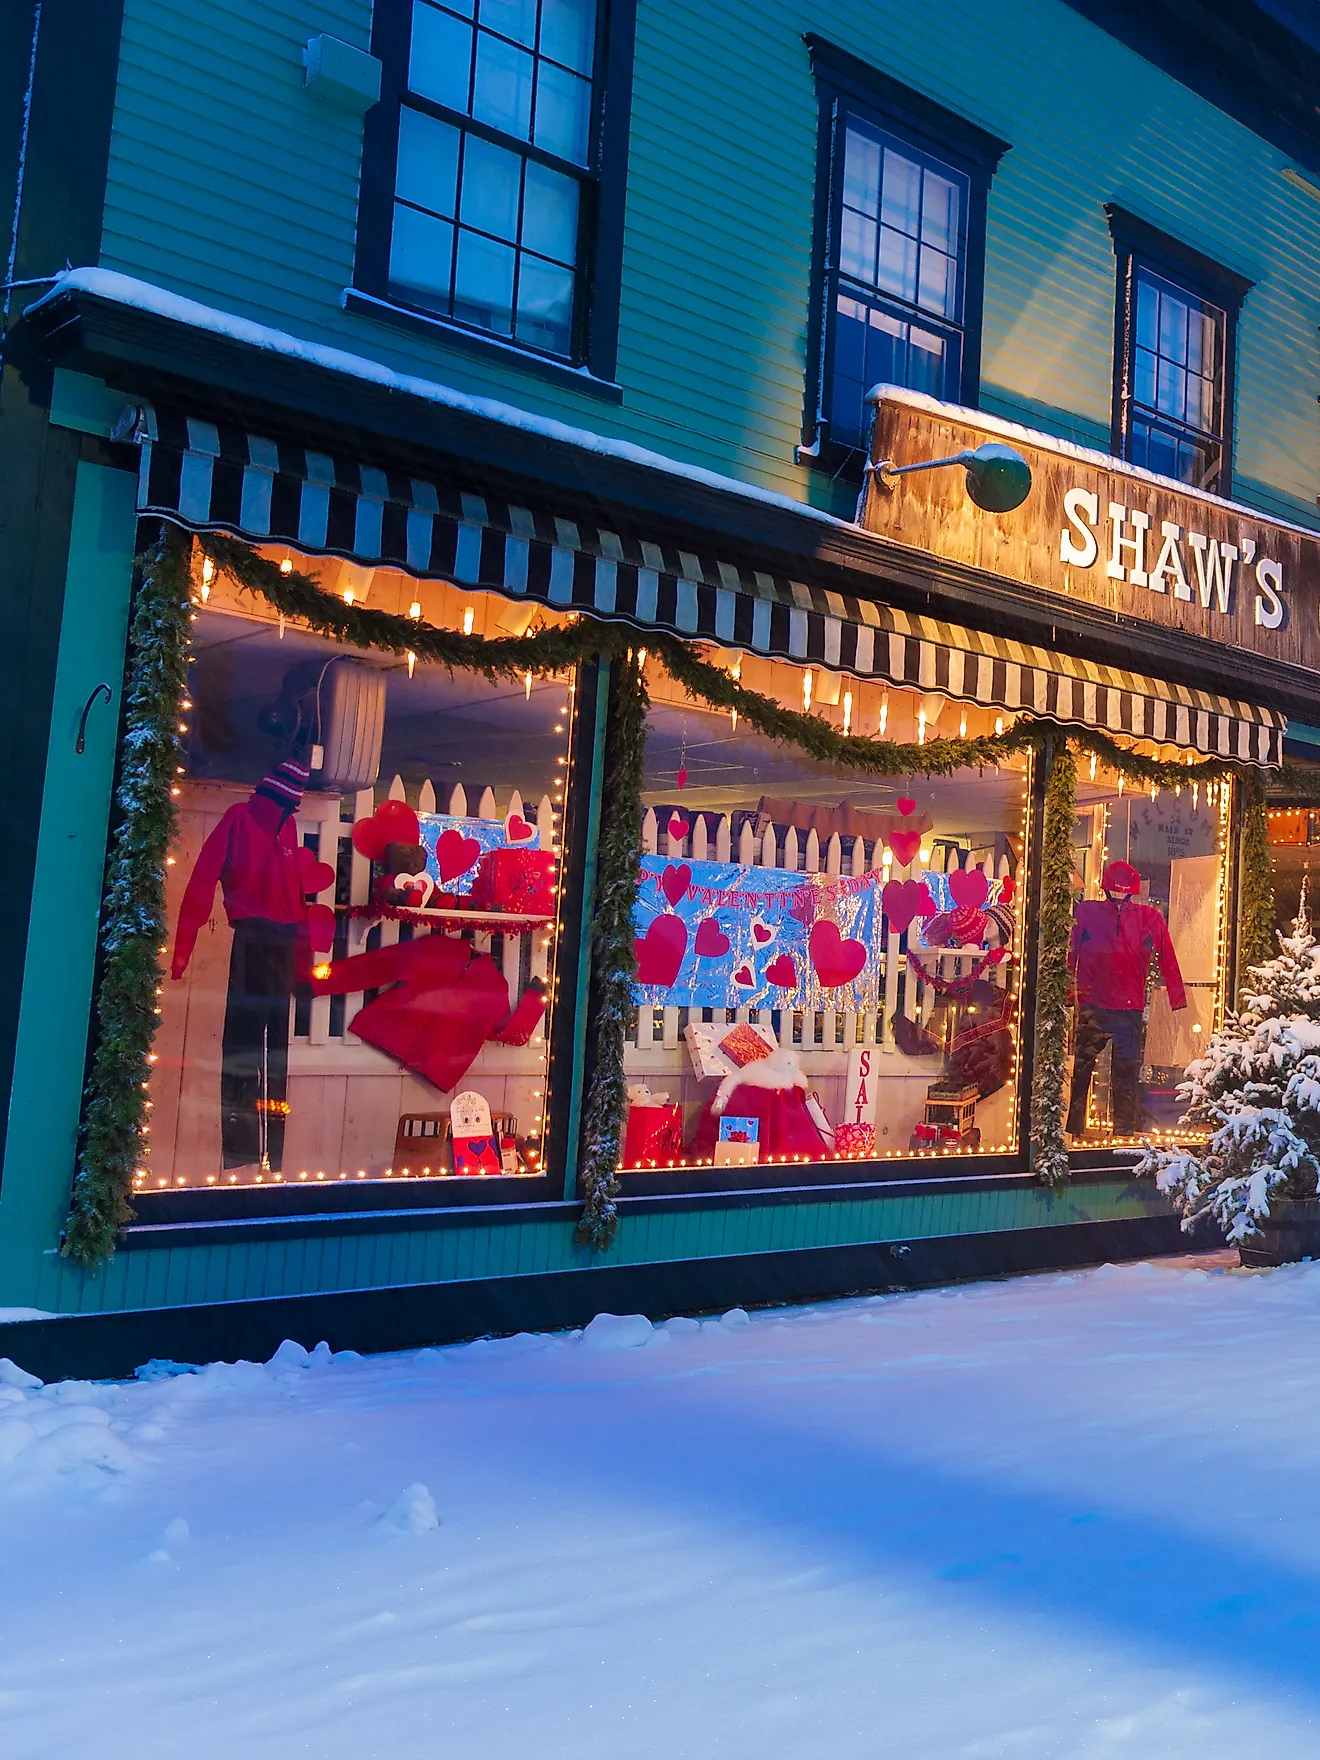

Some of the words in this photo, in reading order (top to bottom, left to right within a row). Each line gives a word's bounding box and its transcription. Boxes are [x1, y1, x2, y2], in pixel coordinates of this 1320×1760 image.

[1060, 487, 1285, 630] SHAW'S
[1158, 824, 1179, 834] MAIN
[849, 866, 882, 894] DAY
[852, 1050, 871, 1125] SAL
